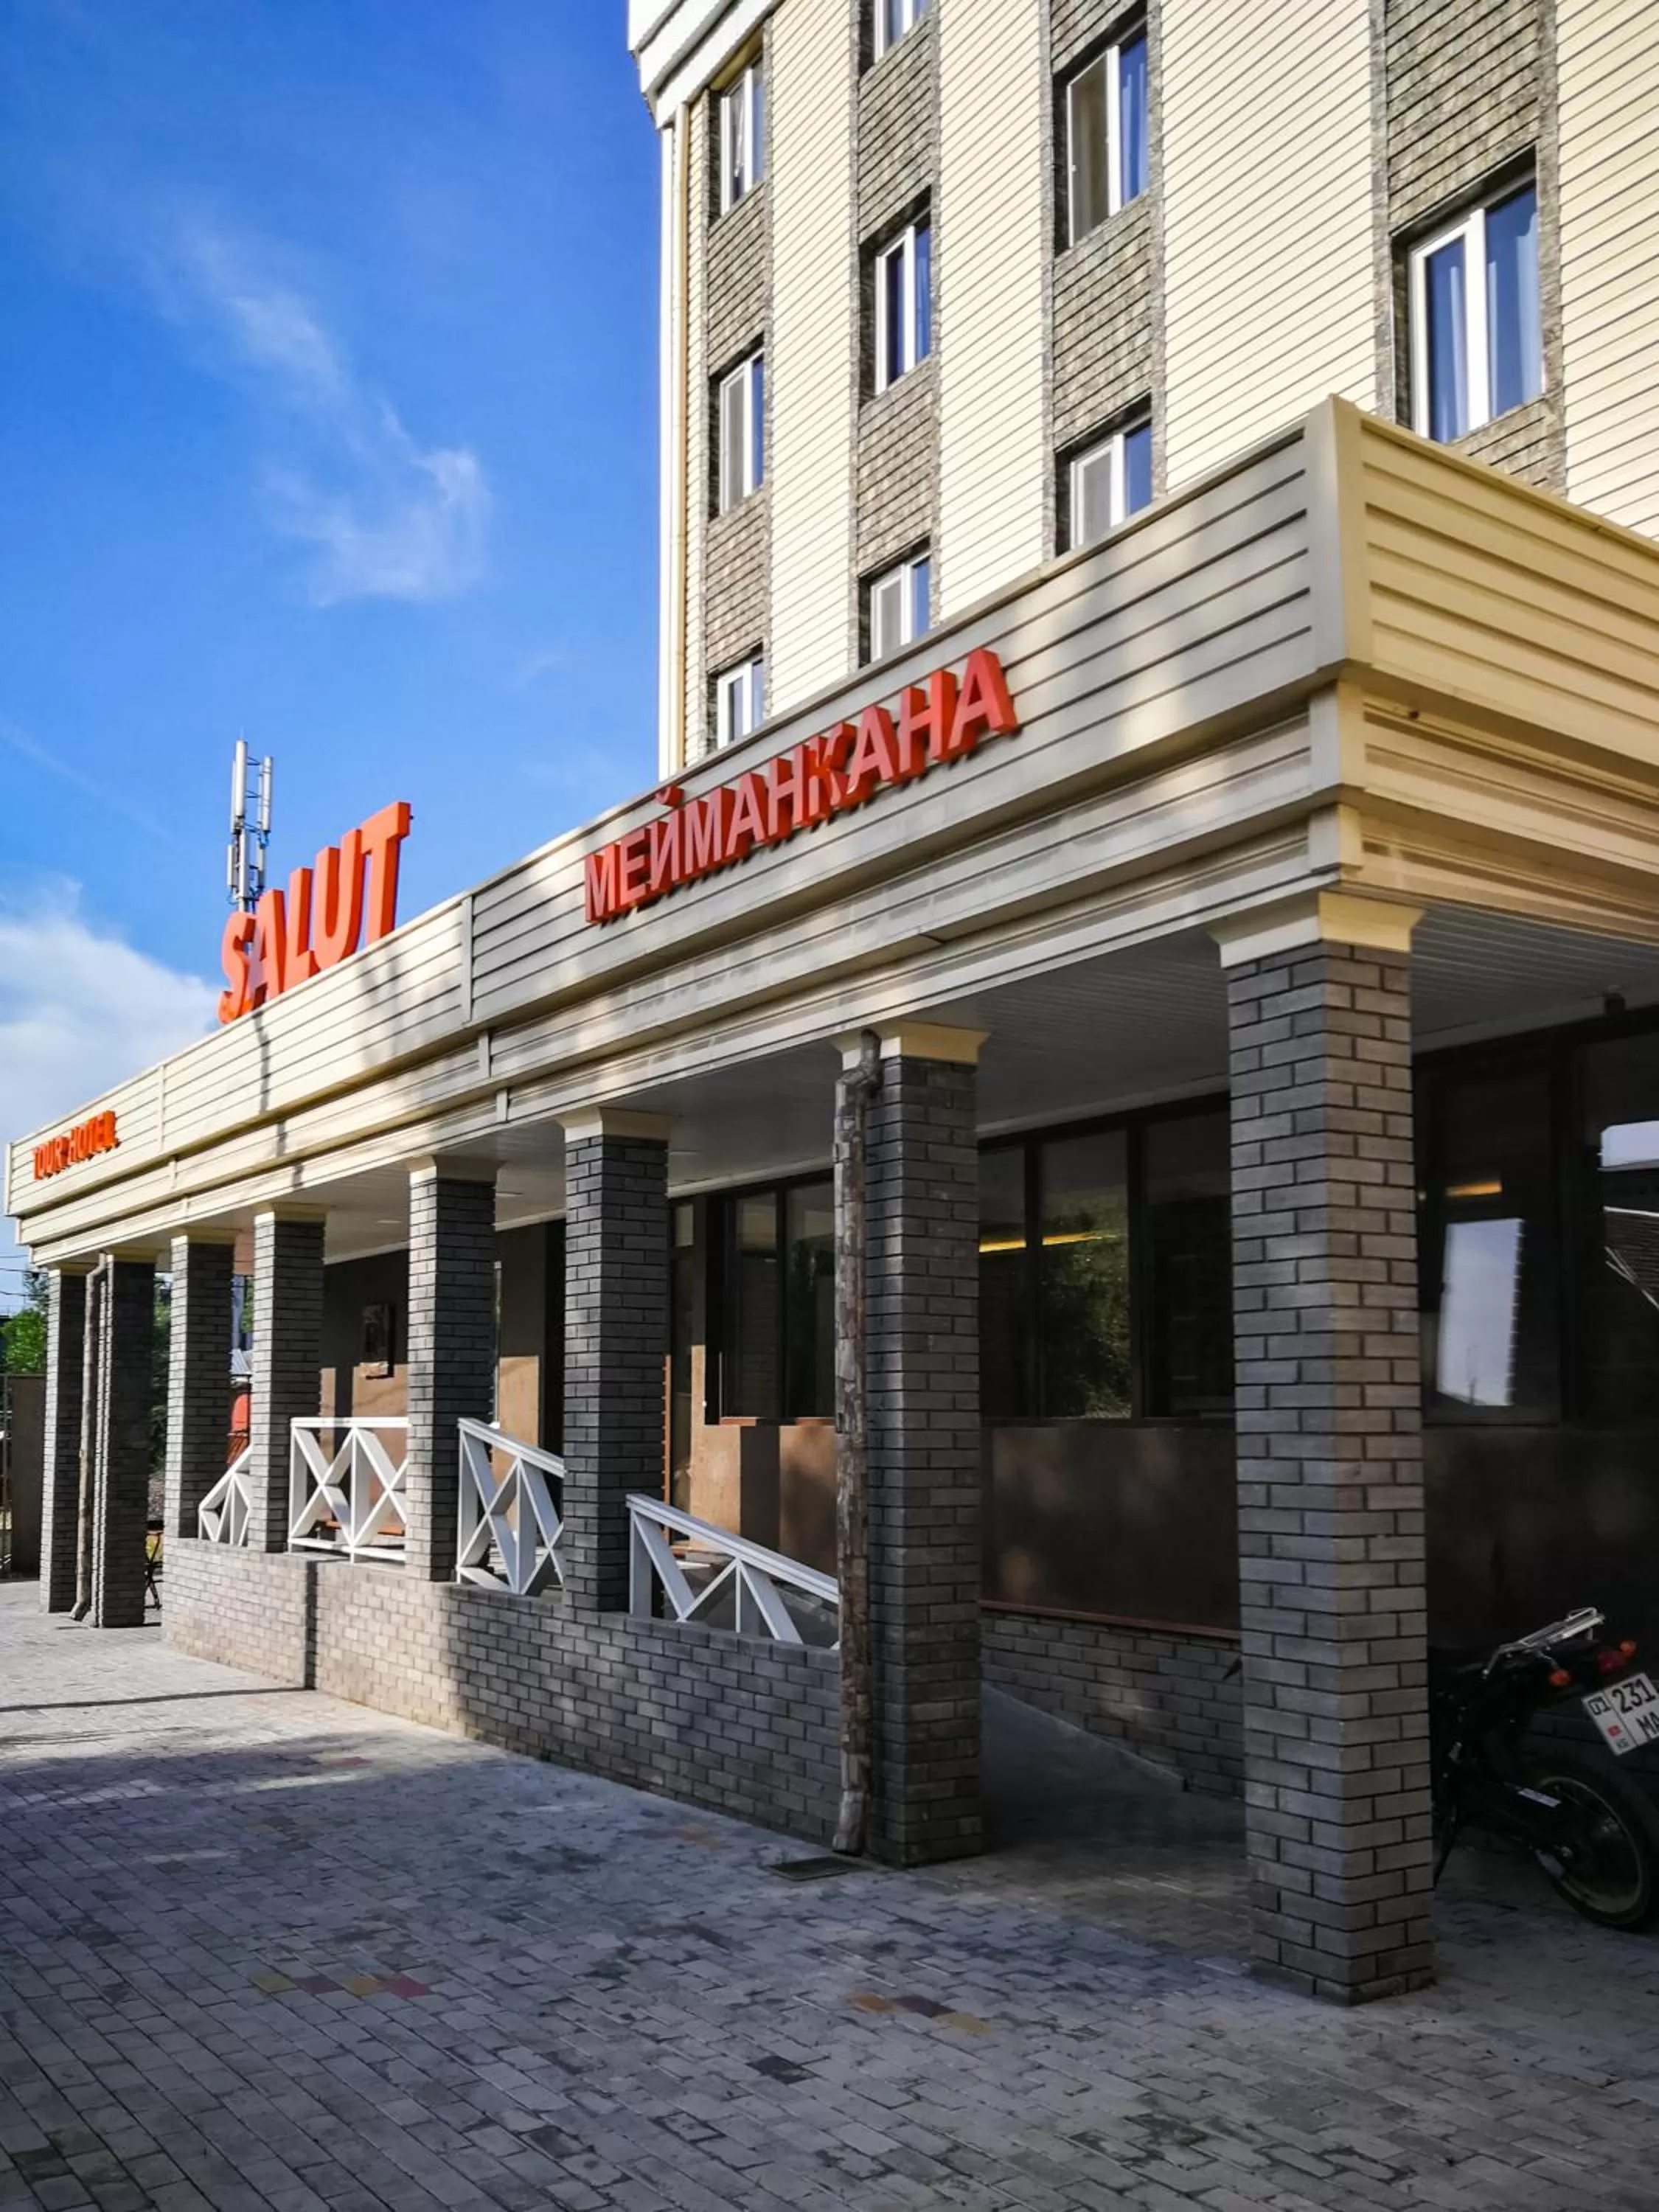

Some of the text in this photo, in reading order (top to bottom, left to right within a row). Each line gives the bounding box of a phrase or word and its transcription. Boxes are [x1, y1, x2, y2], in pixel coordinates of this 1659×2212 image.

[585, 647, 1018, 923] МЕЙМАНКАНА
[218, 801, 411, 1024] SALUT
[33, 1135, 70, 1180] TOUR
[1612, 1678, 1656, 1714] 231
